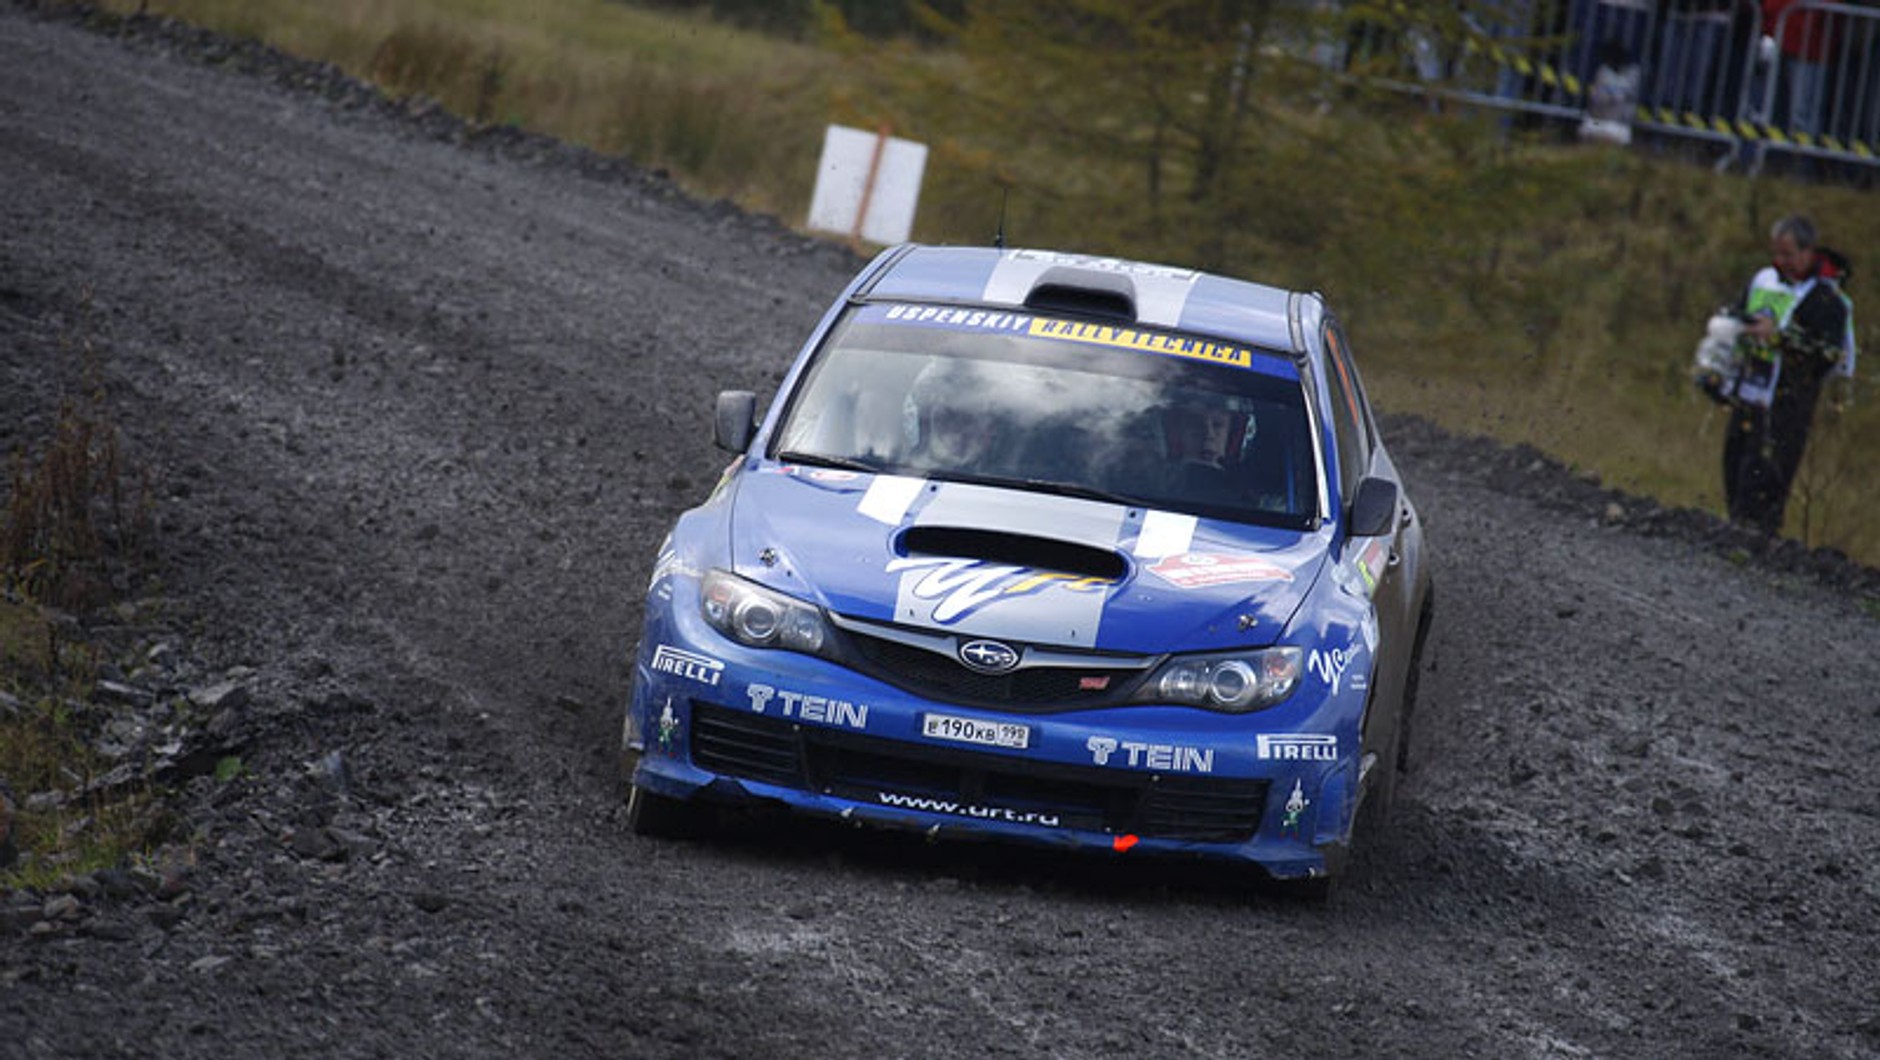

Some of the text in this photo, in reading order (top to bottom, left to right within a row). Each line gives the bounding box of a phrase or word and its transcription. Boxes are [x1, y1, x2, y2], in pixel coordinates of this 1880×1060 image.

[886, 305, 1030, 331] USPENSKIY
[1041, 320, 1122, 341] RALLY
[652, 644, 725, 686] PIRELLI
[778, 690, 868, 729] TEIN
[1121, 742, 1214, 773] TEIN
[1256, 733, 1338, 761] PIRELLI
[879, 792, 1060, 826] www.urt.ru
